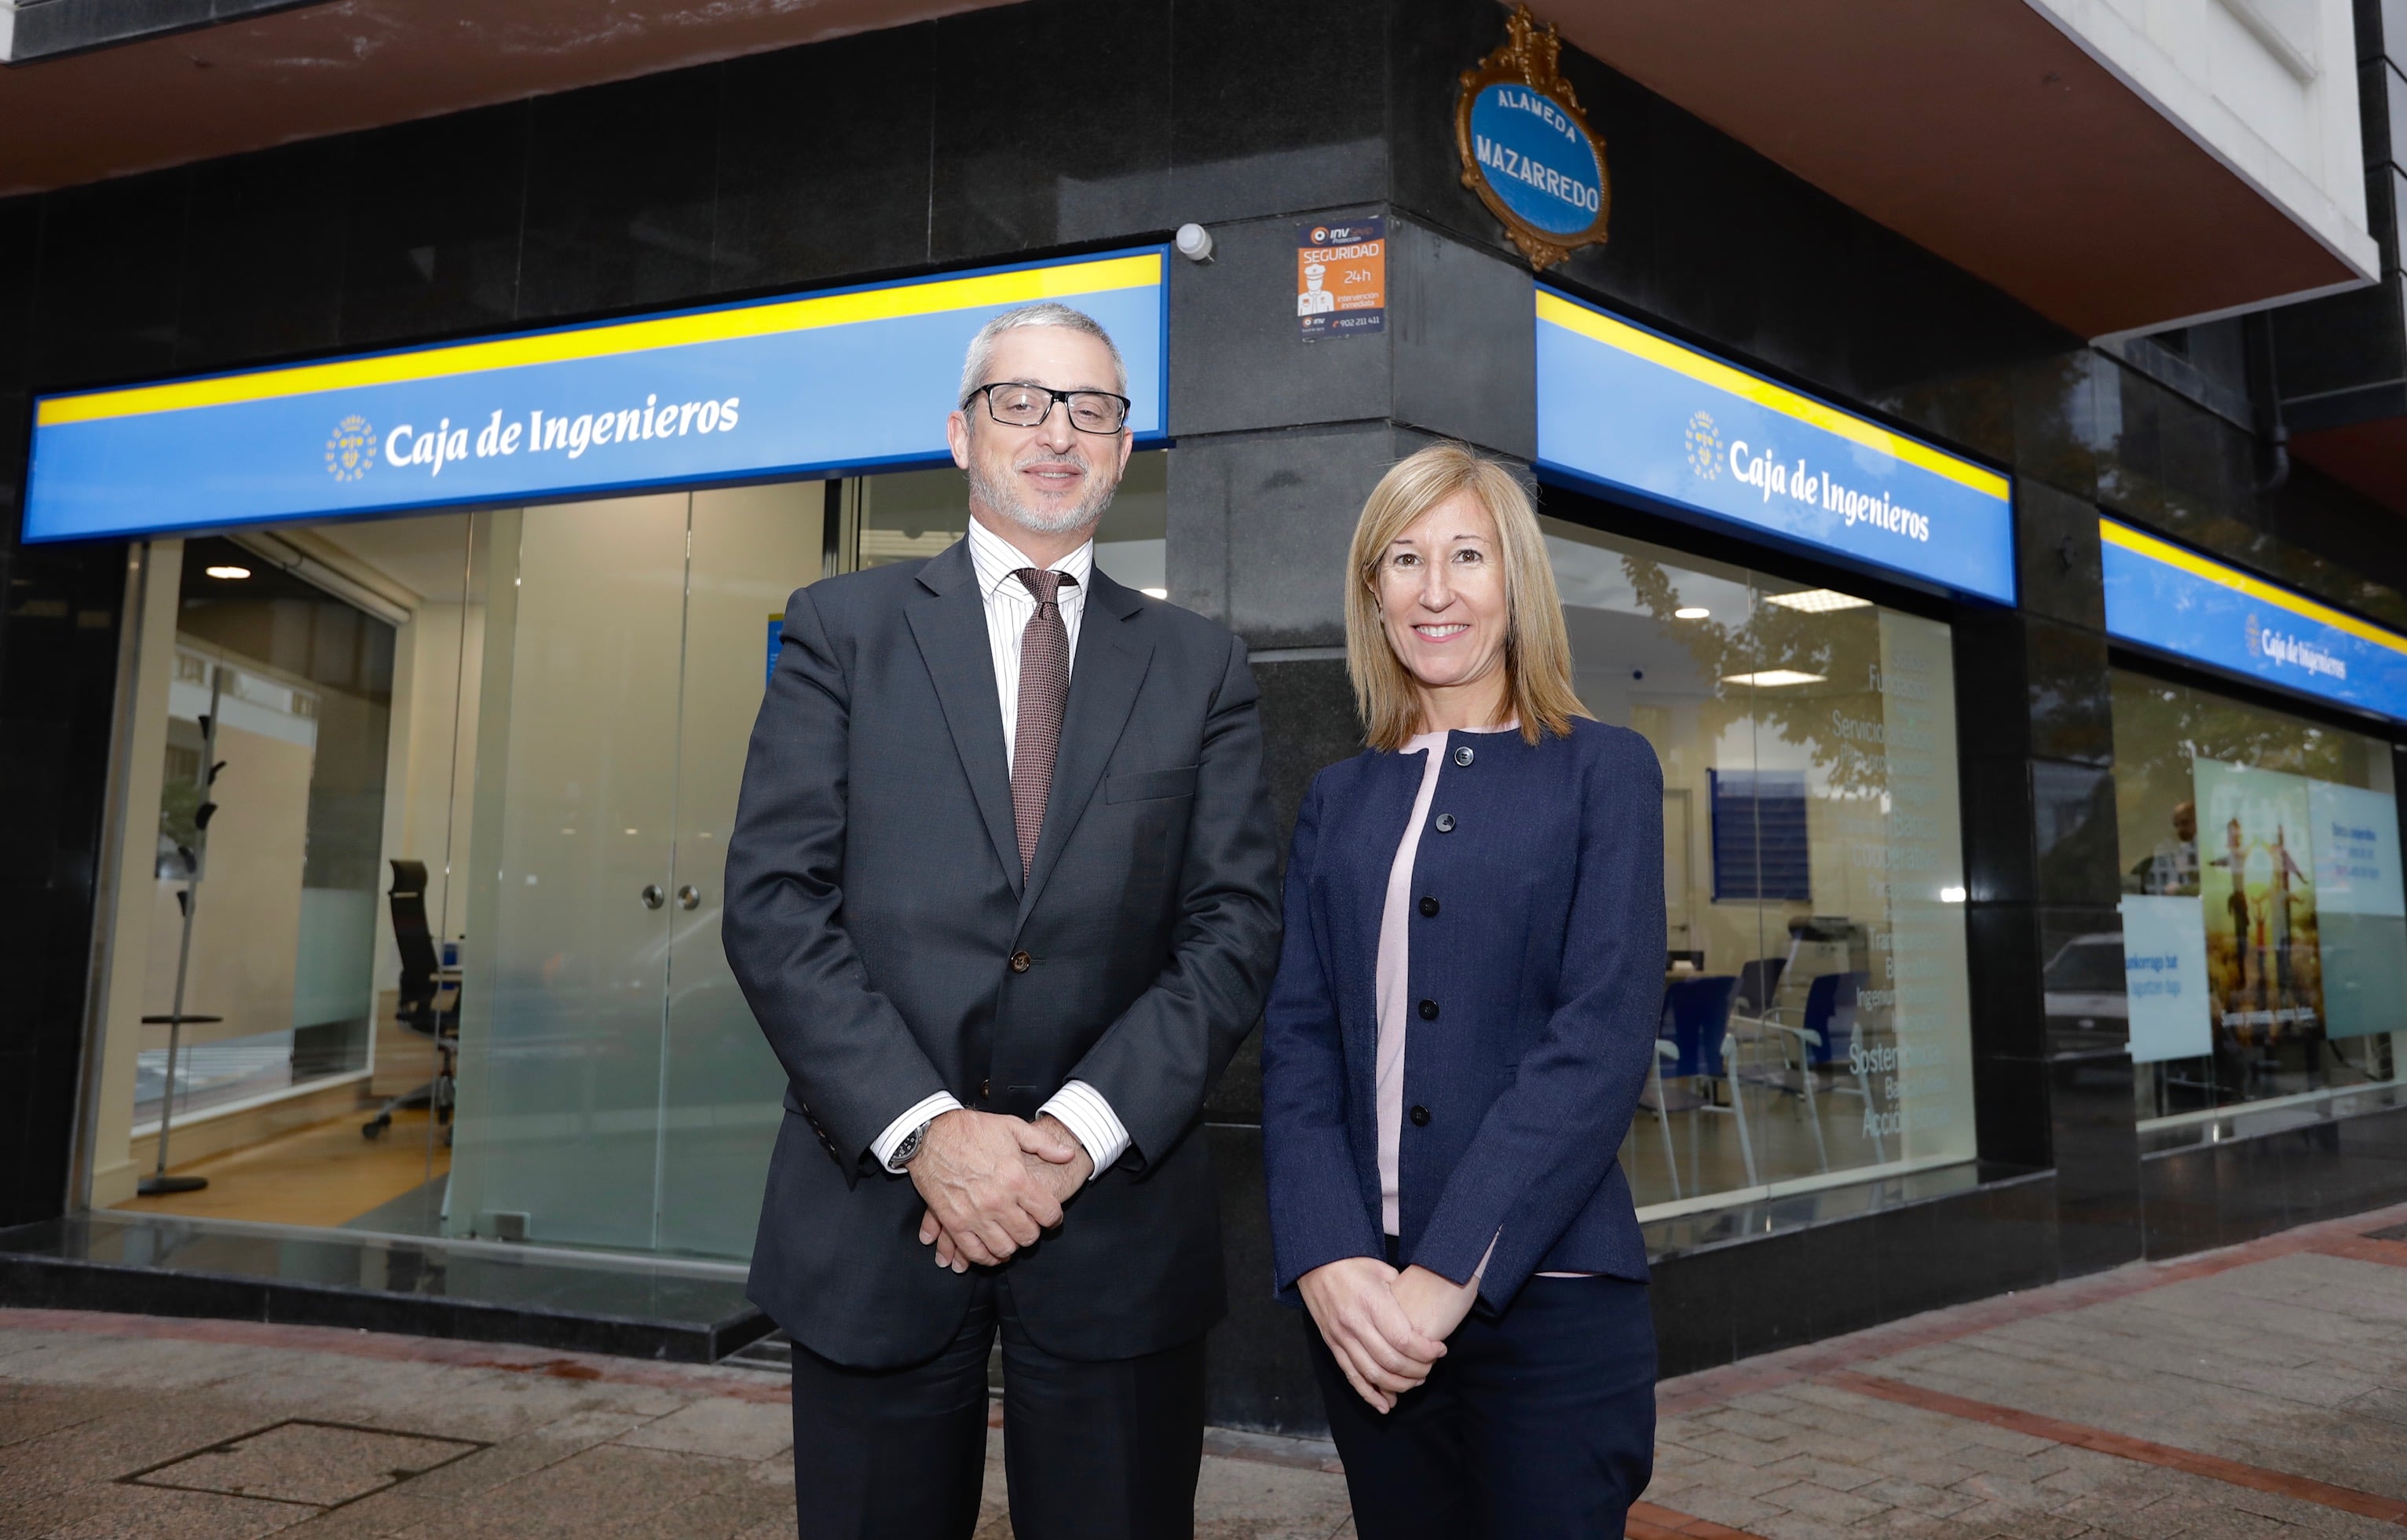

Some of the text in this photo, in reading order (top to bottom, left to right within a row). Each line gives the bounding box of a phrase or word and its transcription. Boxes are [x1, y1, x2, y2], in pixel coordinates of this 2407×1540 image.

[1498, 90, 1575, 144] ALAMEDA
[1476, 135, 1599, 213] MAZARREDO
[1304, 243, 1379, 264] SEGURIDAD
[1355, 317, 1367, 326] 211
[385, 393, 740, 477] Caja de Ingenieros
[1729, 440, 1930, 542] Caja de Ingenieros
[1832, 709, 1885, 744] Servicio
